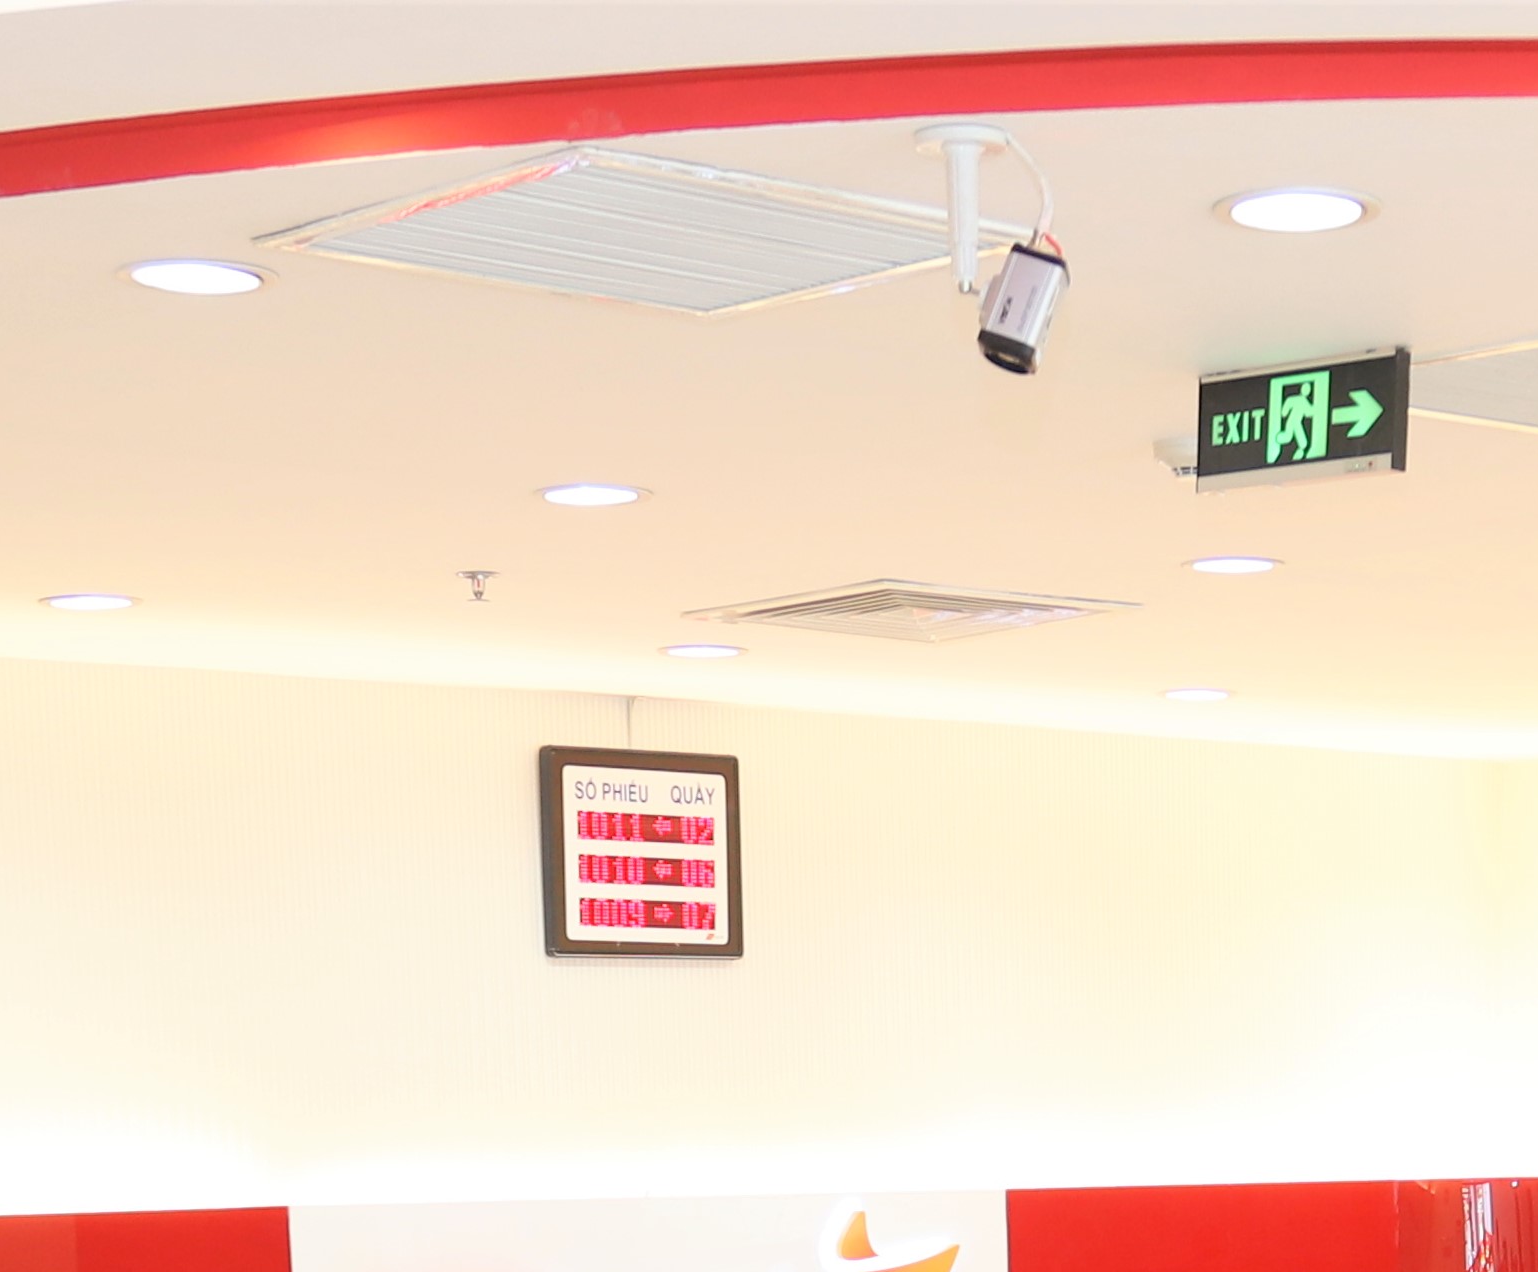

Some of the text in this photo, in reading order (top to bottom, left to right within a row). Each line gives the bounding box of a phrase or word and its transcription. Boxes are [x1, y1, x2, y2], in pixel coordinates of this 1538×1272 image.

[1212, 408, 1265, 446] EXIT
[578, 811, 714, 846] 1011 02
[579, 854, 644, 885] 1010
[681, 902, 716, 930] 07
